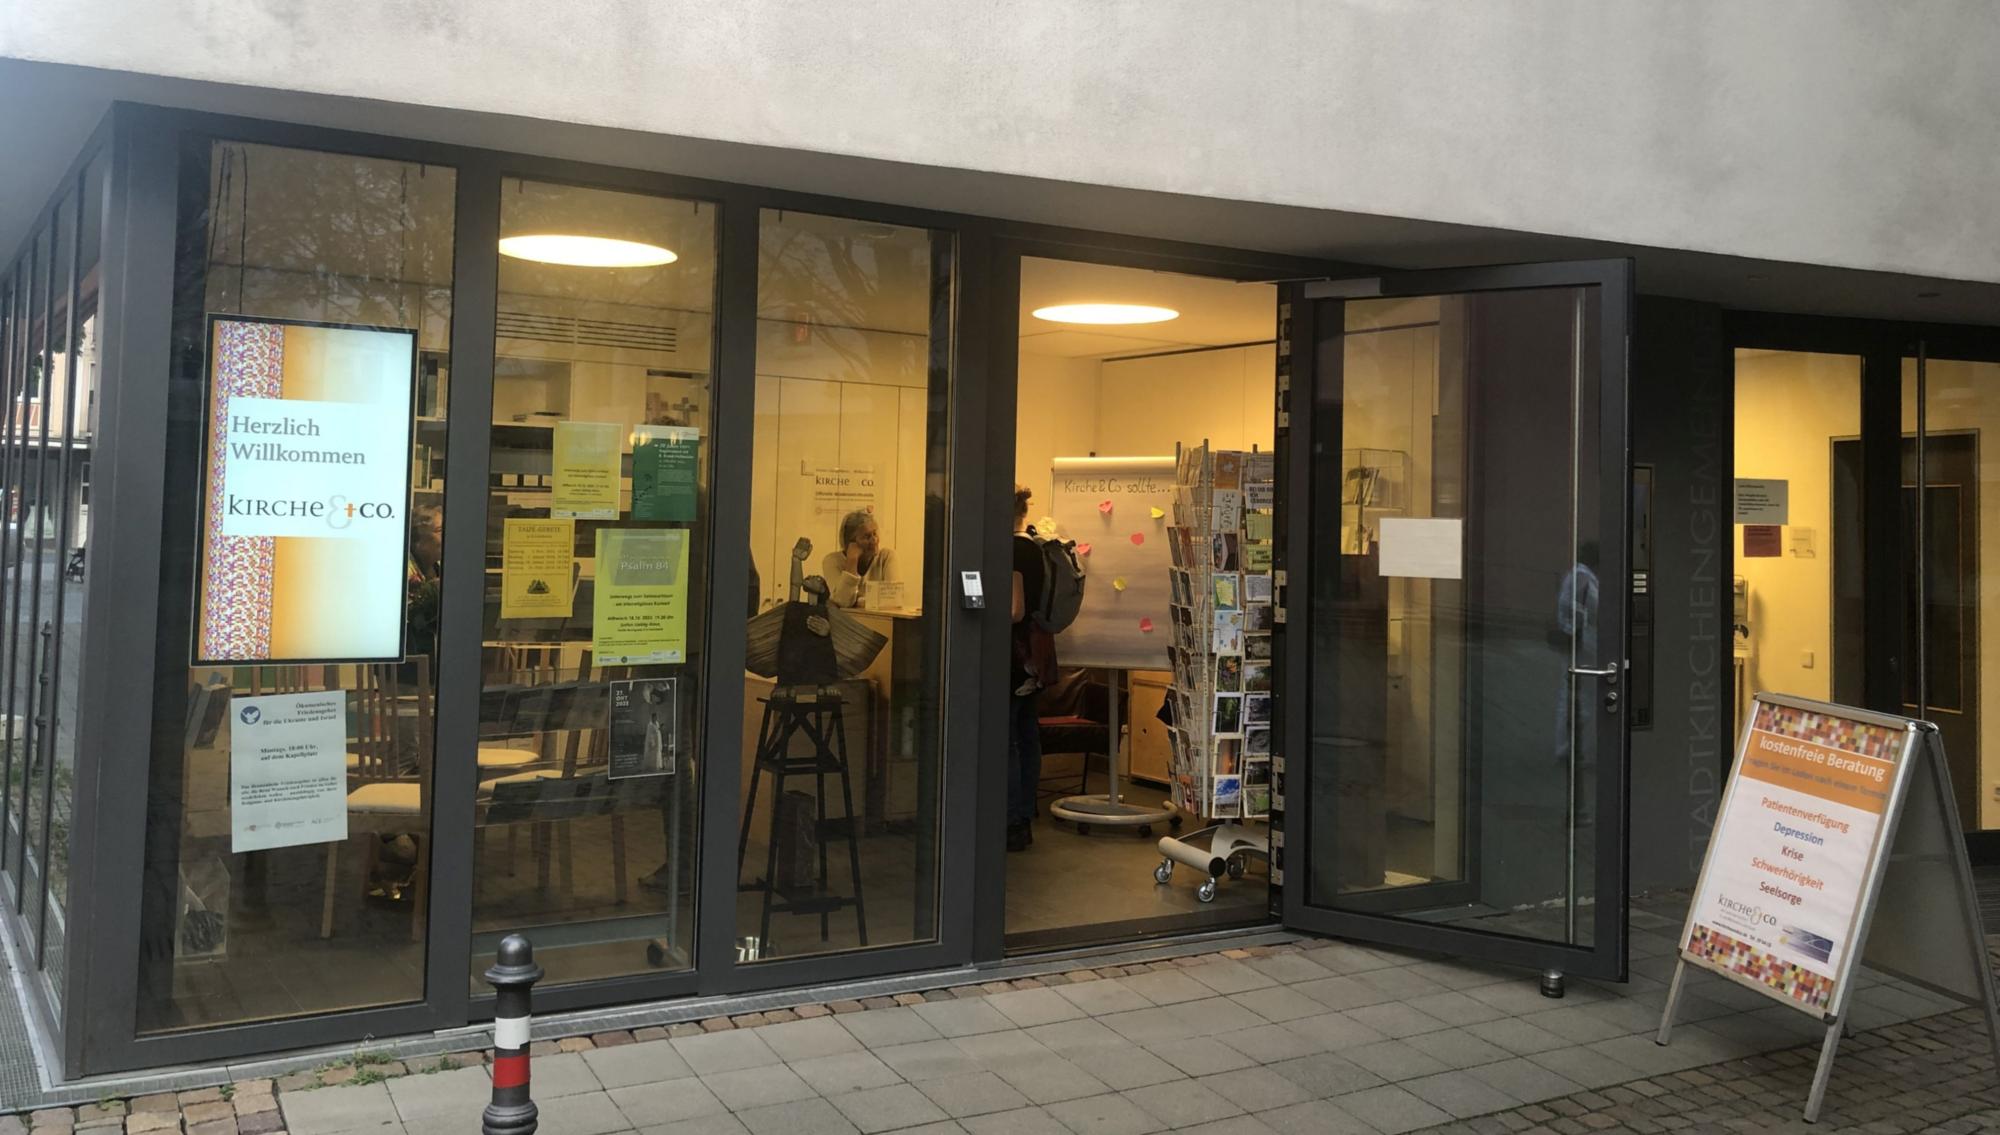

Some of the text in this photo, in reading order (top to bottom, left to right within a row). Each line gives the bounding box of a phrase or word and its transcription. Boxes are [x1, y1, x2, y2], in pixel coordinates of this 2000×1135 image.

[232, 415, 320, 436] Herzlich
[231, 442, 365, 464] Willkommen
[1760, 735, 1886, 782] kostenfreie Beratung
[1761, 797, 1850, 834] Patientenverfügung
[1774, 821, 1824, 846] Depression
[1781, 845, 1804, 861] Krise
[1751, 857, 1824, 891] Schwerhörigkeit
[1759, 881, 1802, 905] Seelsorge
